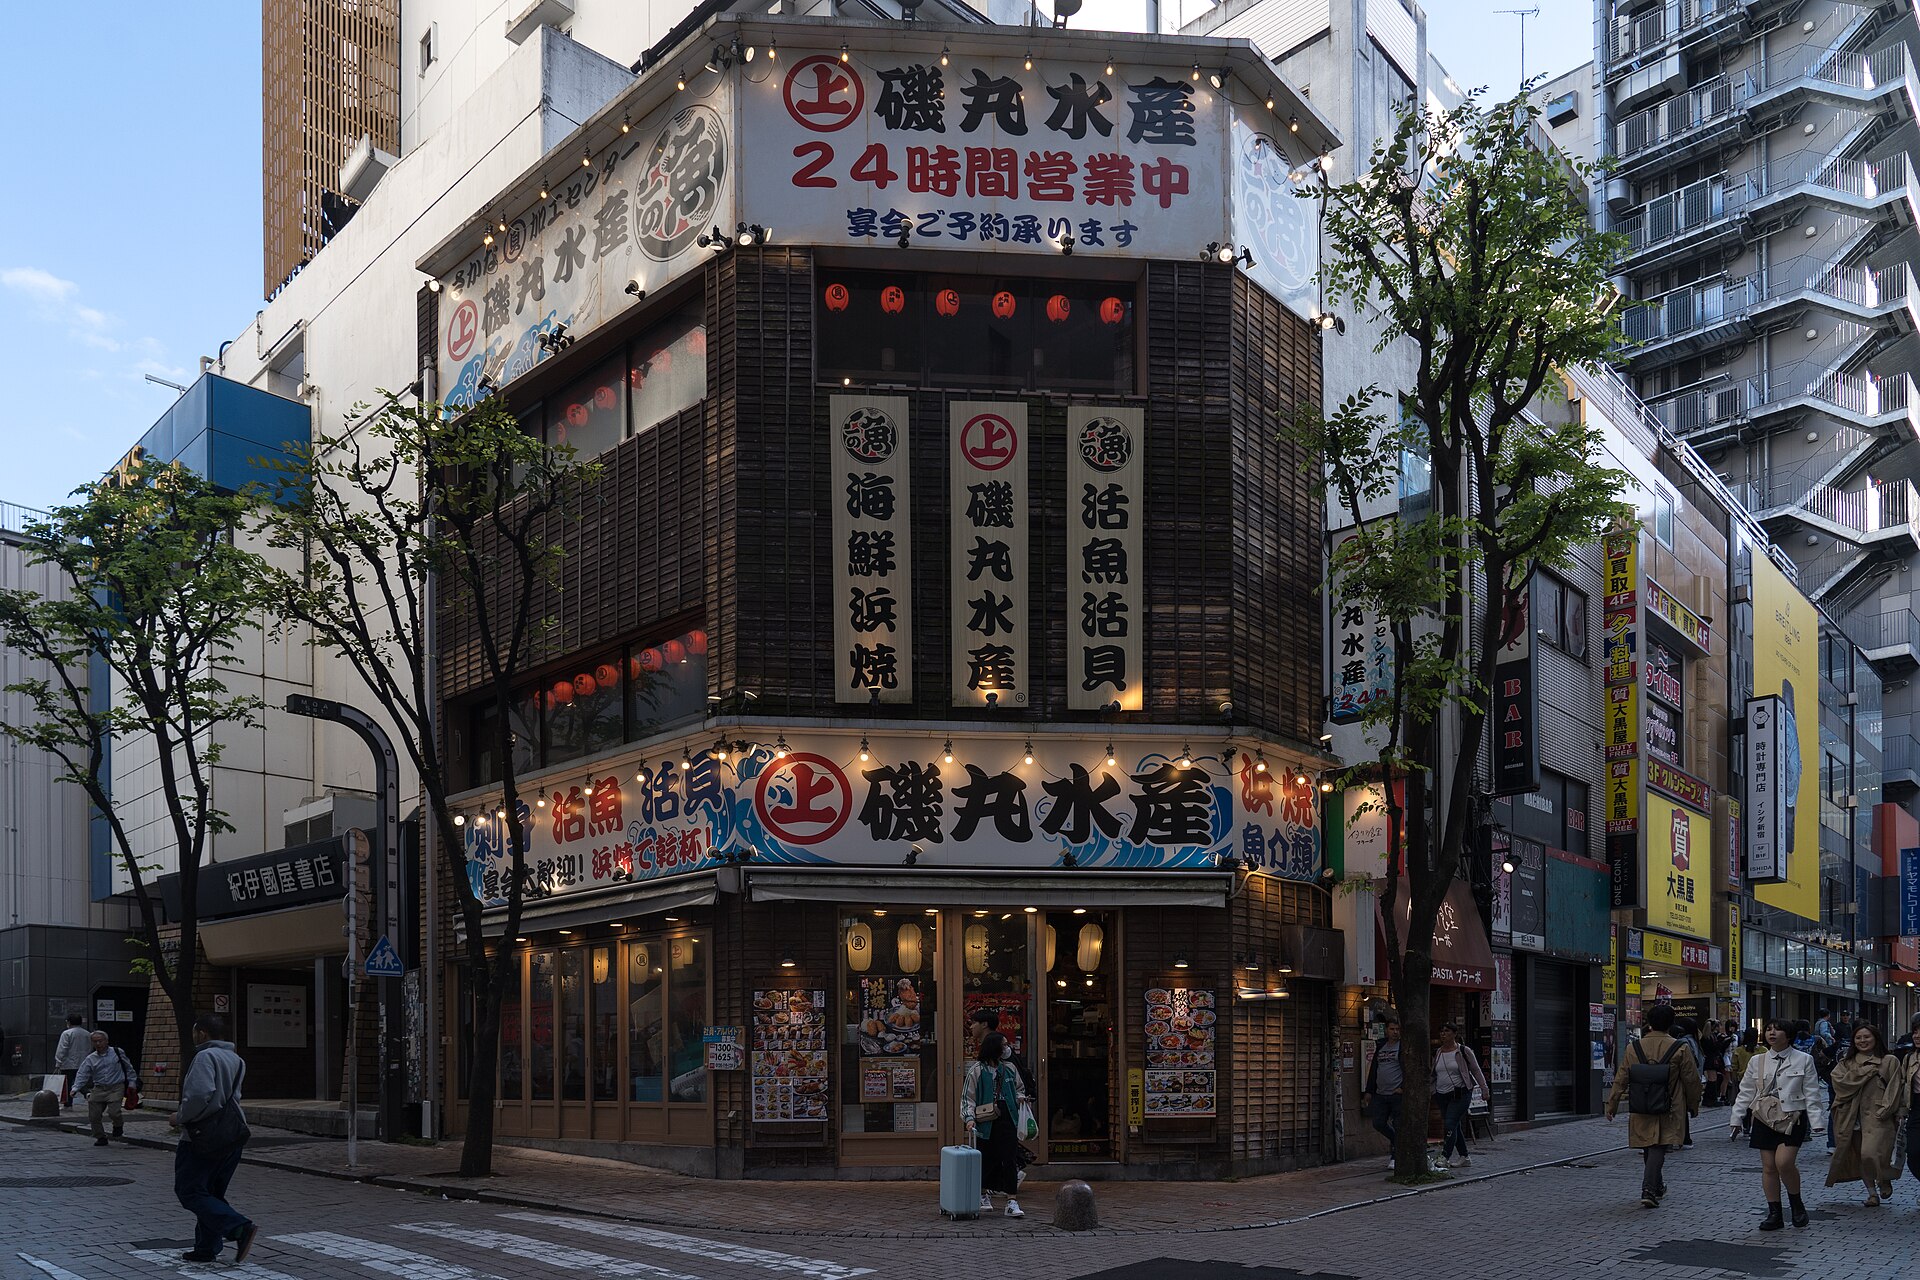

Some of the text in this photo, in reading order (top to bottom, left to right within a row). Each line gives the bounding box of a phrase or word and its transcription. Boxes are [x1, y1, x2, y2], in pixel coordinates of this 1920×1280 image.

[874, 63, 1197, 147] 磯丸水産
[791, 140, 1190, 209] 24時間営業中
[846, 206, 1139, 248] 宴会ご予約承ります
[481, 188, 629, 337] 磯丸水産
[846, 472, 898, 690] 海鮮浜焼
[966, 480, 1015, 691] 磯丸水産
[1081, 483, 1130, 692] 活魚活貝
[1610, 557, 1628, 593] 買取
[1609, 592, 1630, 606] 4F
[1647, 587, 1659, 607] 4F
[1697, 627, 1708, 646] 4F
[1609, 613, 1632, 681] タイ料理
[1775, 609, 1801, 643] BREITLING
[1646, 661, 1681, 707] タイ料理
[1504, 678, 1523, 749] BAR
[1612, 703, 1628, 745] 大黒屋
[1609, 742, 1633, 752] DUTY
[1609, 748, 1633, 757] FREE
[1755, 741, 1767, 793] 時計専門店
[640, 749, 723, 824] 活貝
[857, 760, 1212, 846] 磯丸水産
[1240, 752, 1314, 829] 浜焼
[1524, 792, 1553, 815] MACHIBAR
[1612, 778, 1628, 819] 大黒屋
[1648, 760, 1660, 784] 3F
[1662, 769, 1696, 801] クルンテープ
[551, 775, 624, 845] 活魚
[1567, 808, 1585, 832] BAR
[1609, 816, 1633, 826] DUTY
[1609, 823, 1633, 833] FREE
[1756, 801, 1767, 839] イシダ新宿
[1241, 821, 1314, 877] 魚介類
[1673, 817, 1689, 863] 質
[227, 853, 336, 902] 紀伊國屋書店
[1614, 859, 1622, 906] ONE COIN
[1666, 871, 1695, 904] 大黒屋
[1749, 864, 1773, 874] ISHIDA
[1907, 872, 1918, 935] ヤマモトコーヒー店
[715, 1043, 732, 1052] 1300
[715, 1053, 732, 1061] 1625
[1130, 1084, 1140, 1114] 一番搾り
